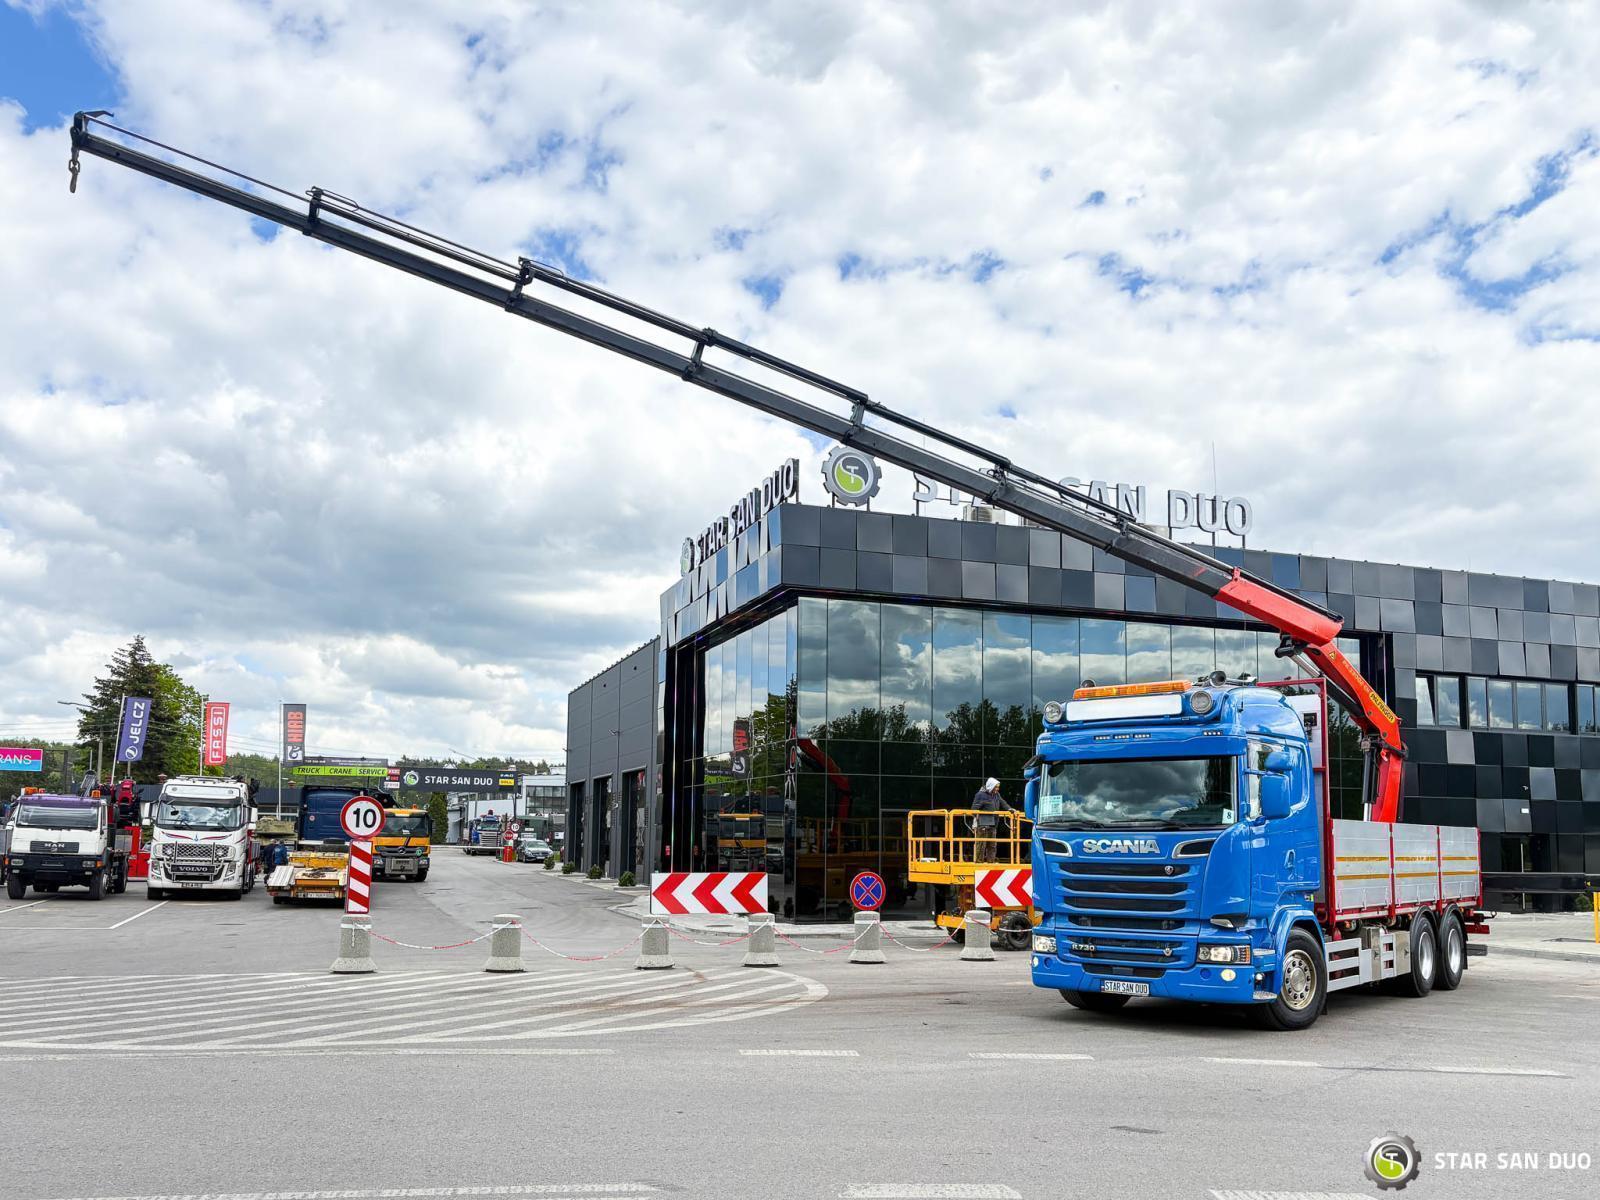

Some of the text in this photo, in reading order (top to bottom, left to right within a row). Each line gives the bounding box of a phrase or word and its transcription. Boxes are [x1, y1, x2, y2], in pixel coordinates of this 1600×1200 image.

[696, 457, 799, 566] STAR SAN DUO
[1167, 488, 1253, 537] DUO
[129, 701, 146, 744] JELCZ
[287, 711, 304, 743] HIAB
[212, 711, 224, 759] FASSI
[296, 766, 321, 775] TRUCK
[329, 767, 353, 775] CRANE
[424, 775, 493, 787] STAR SAN DUO
[352, 807, 377, 829] 10
[1082, 838, 1161, 855] SCANIA
[179, 865, 208, 873] VOLVO
[1104, 981, 1120, 992] STAR
[1121, 982, 1134, 993] SAN
